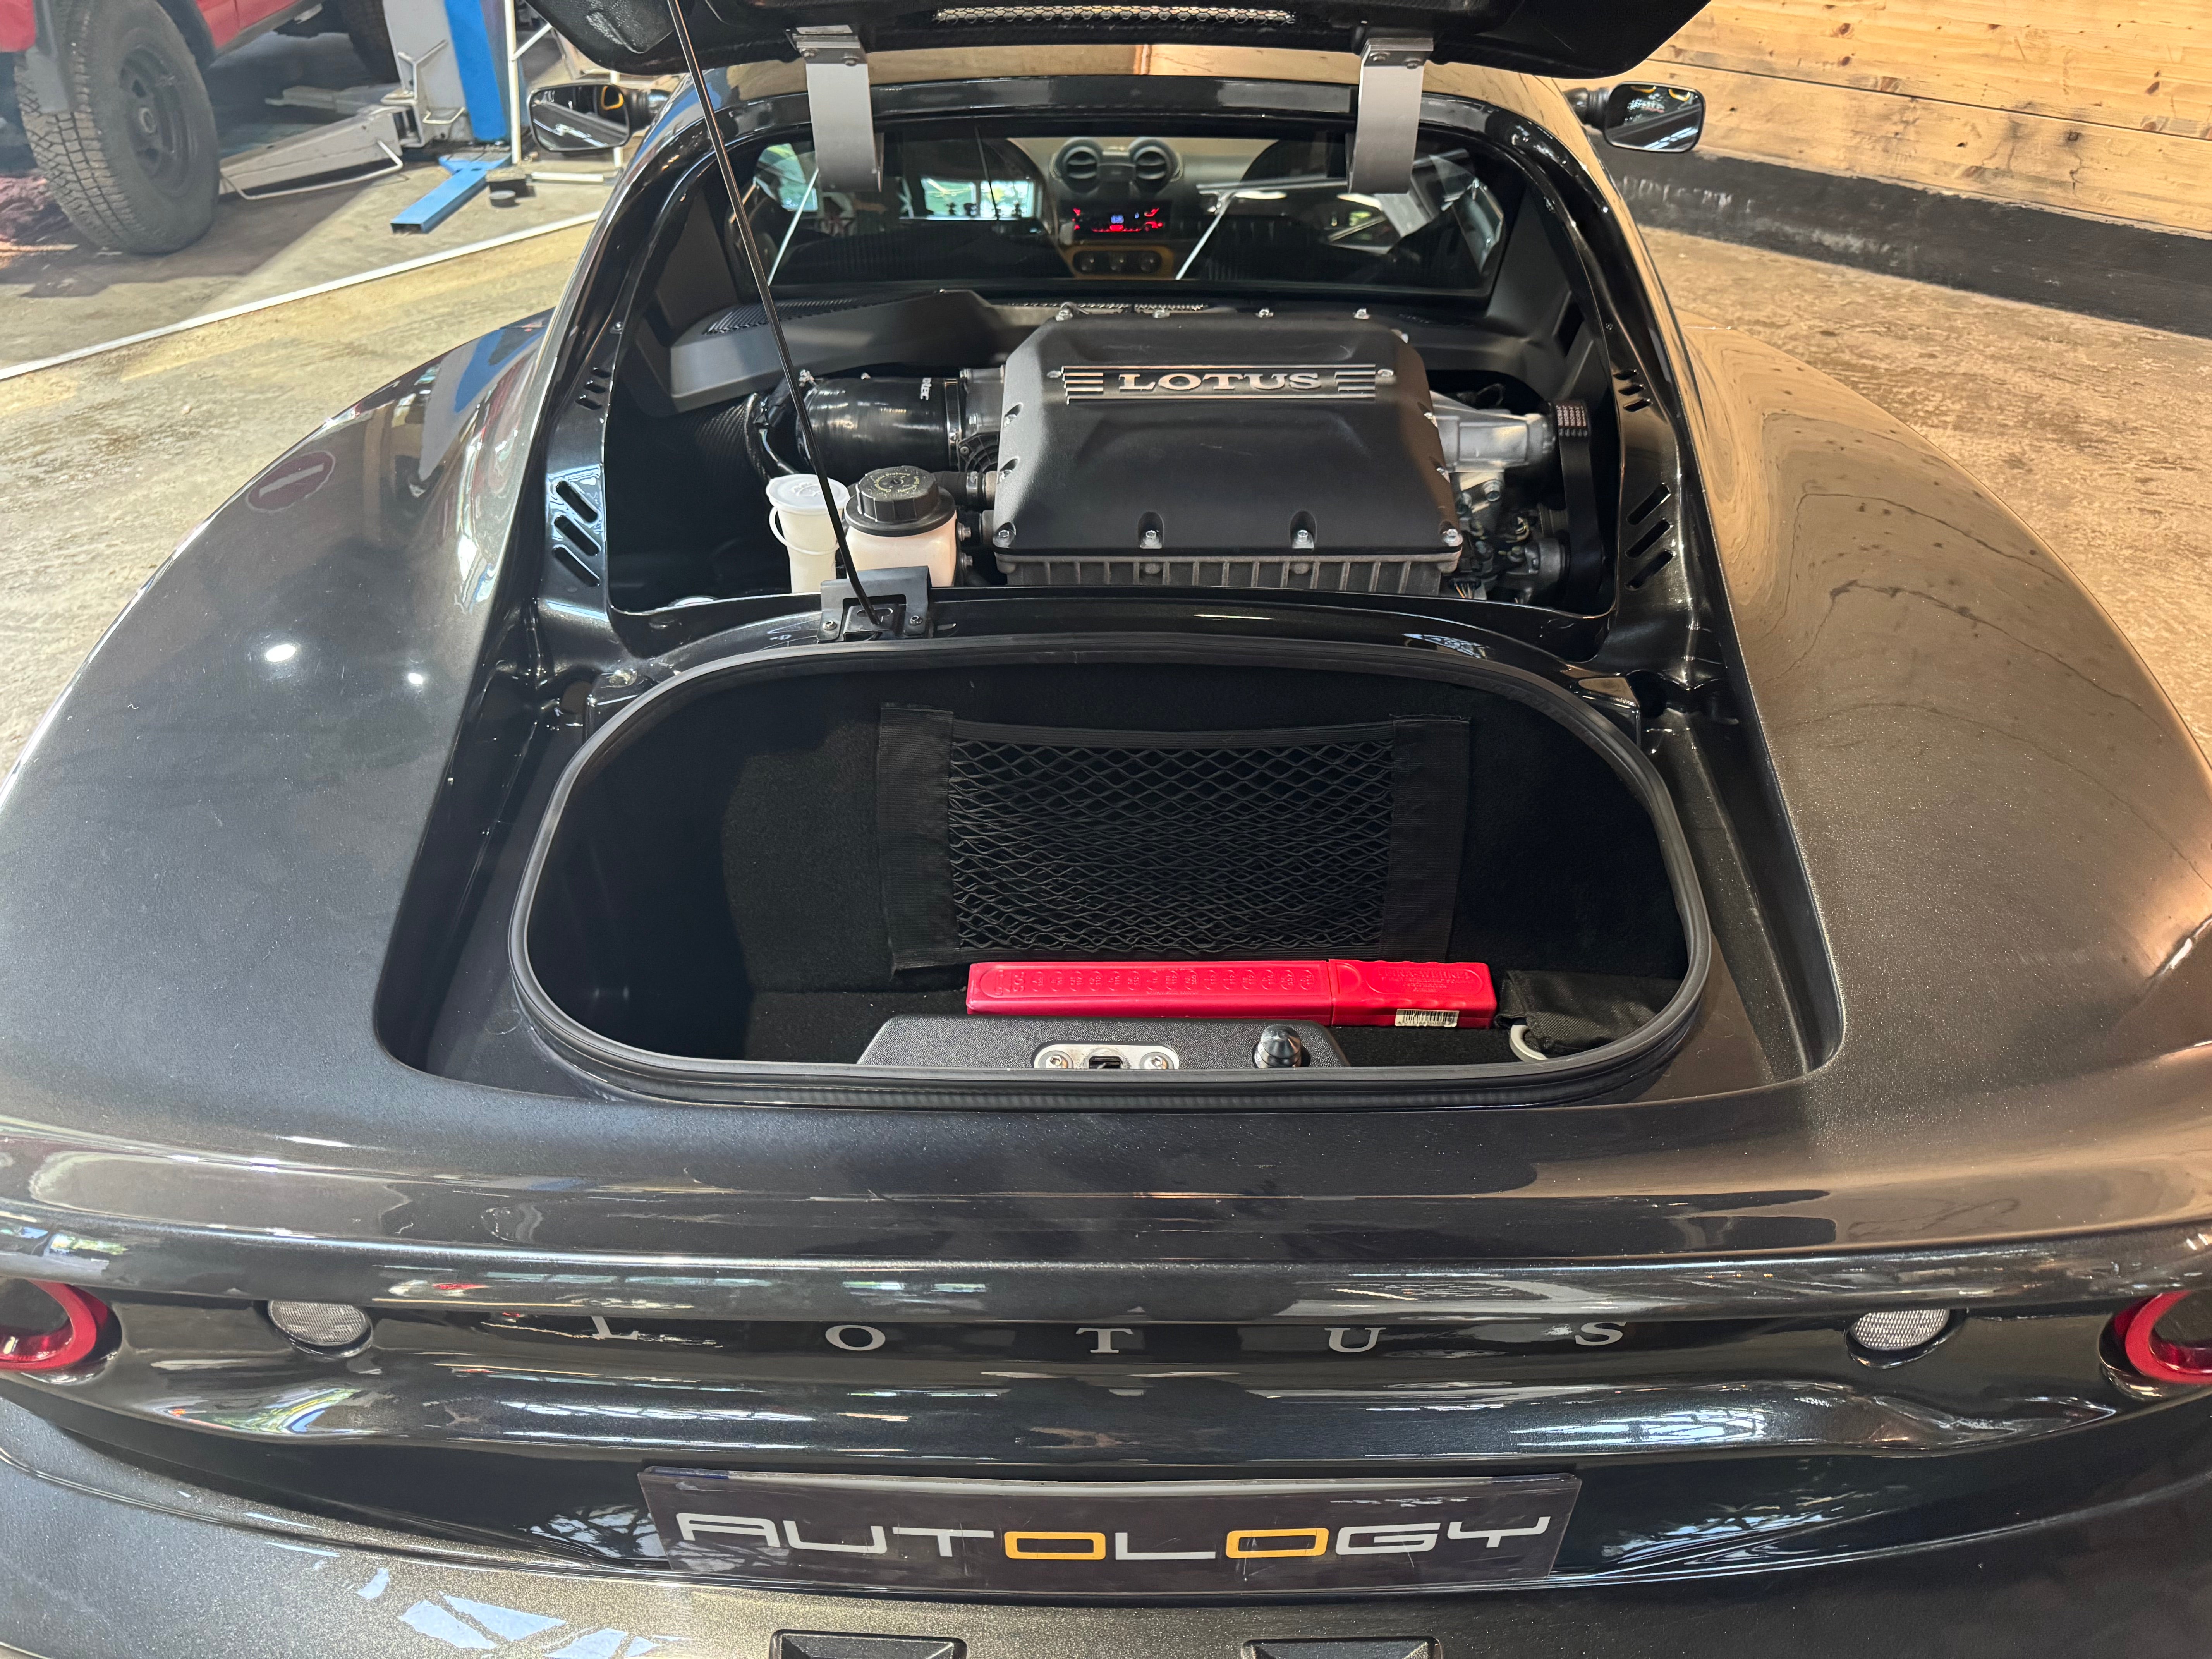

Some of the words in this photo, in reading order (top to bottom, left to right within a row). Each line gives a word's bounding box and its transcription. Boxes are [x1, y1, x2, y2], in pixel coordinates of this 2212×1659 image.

[1119, 373, 1321, 391] LOTUS
[591, 1316, 1626, 1353] LOTUS
[676, 1513, 1551, 1560] AUTOLOGY
